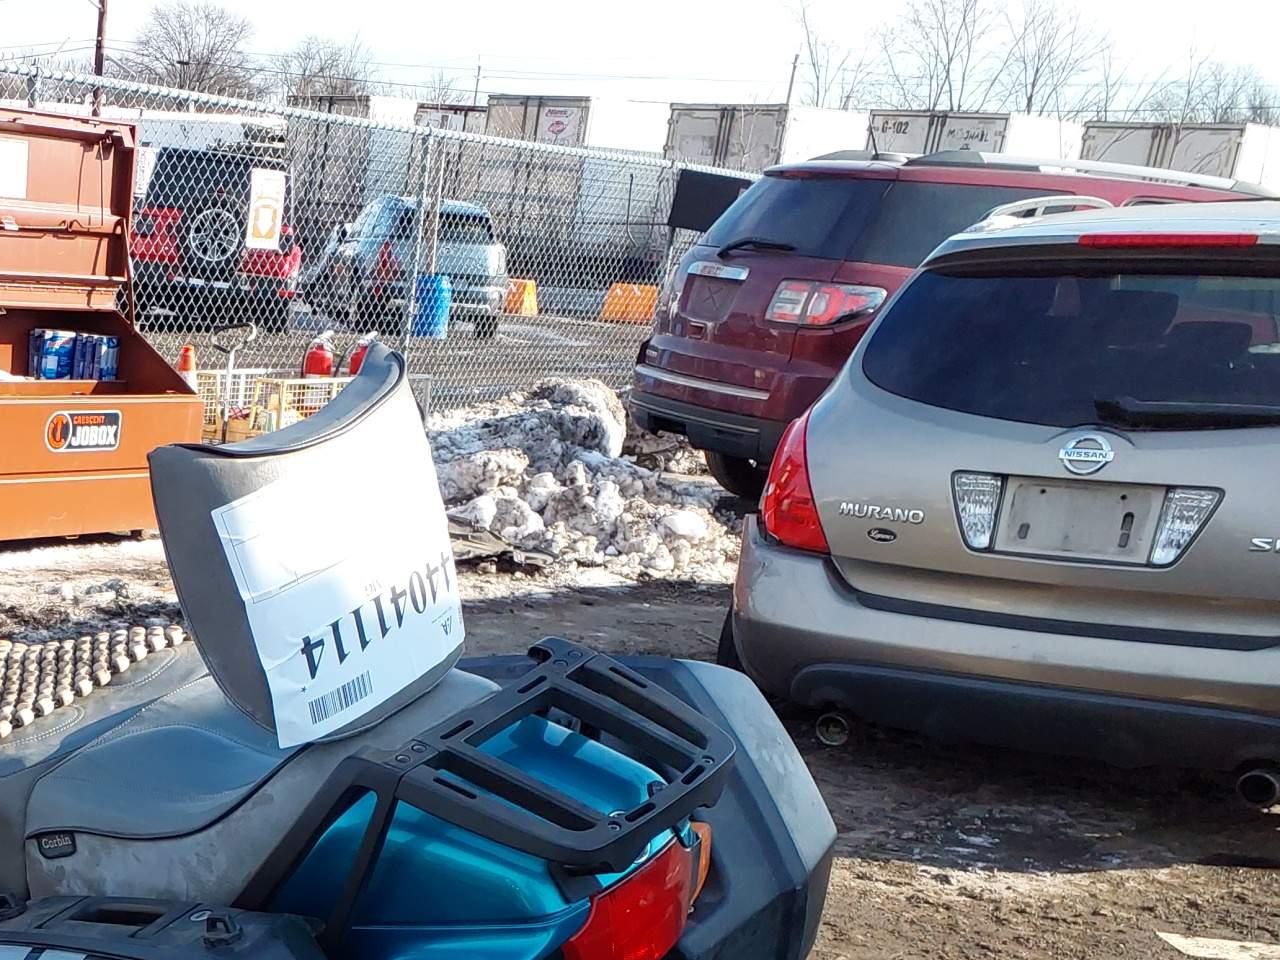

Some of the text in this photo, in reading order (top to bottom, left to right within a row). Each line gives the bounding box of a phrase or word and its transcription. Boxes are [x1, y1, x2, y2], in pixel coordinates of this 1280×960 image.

[72, 415, 105, 425] CRESCENT
[70, 425, 118, 447] JOBOX
[1064, 450, 1108, 459] NISSAN
[839, 501, 925, 524] MURANO
[41, 834, 73, 849] Corbin
